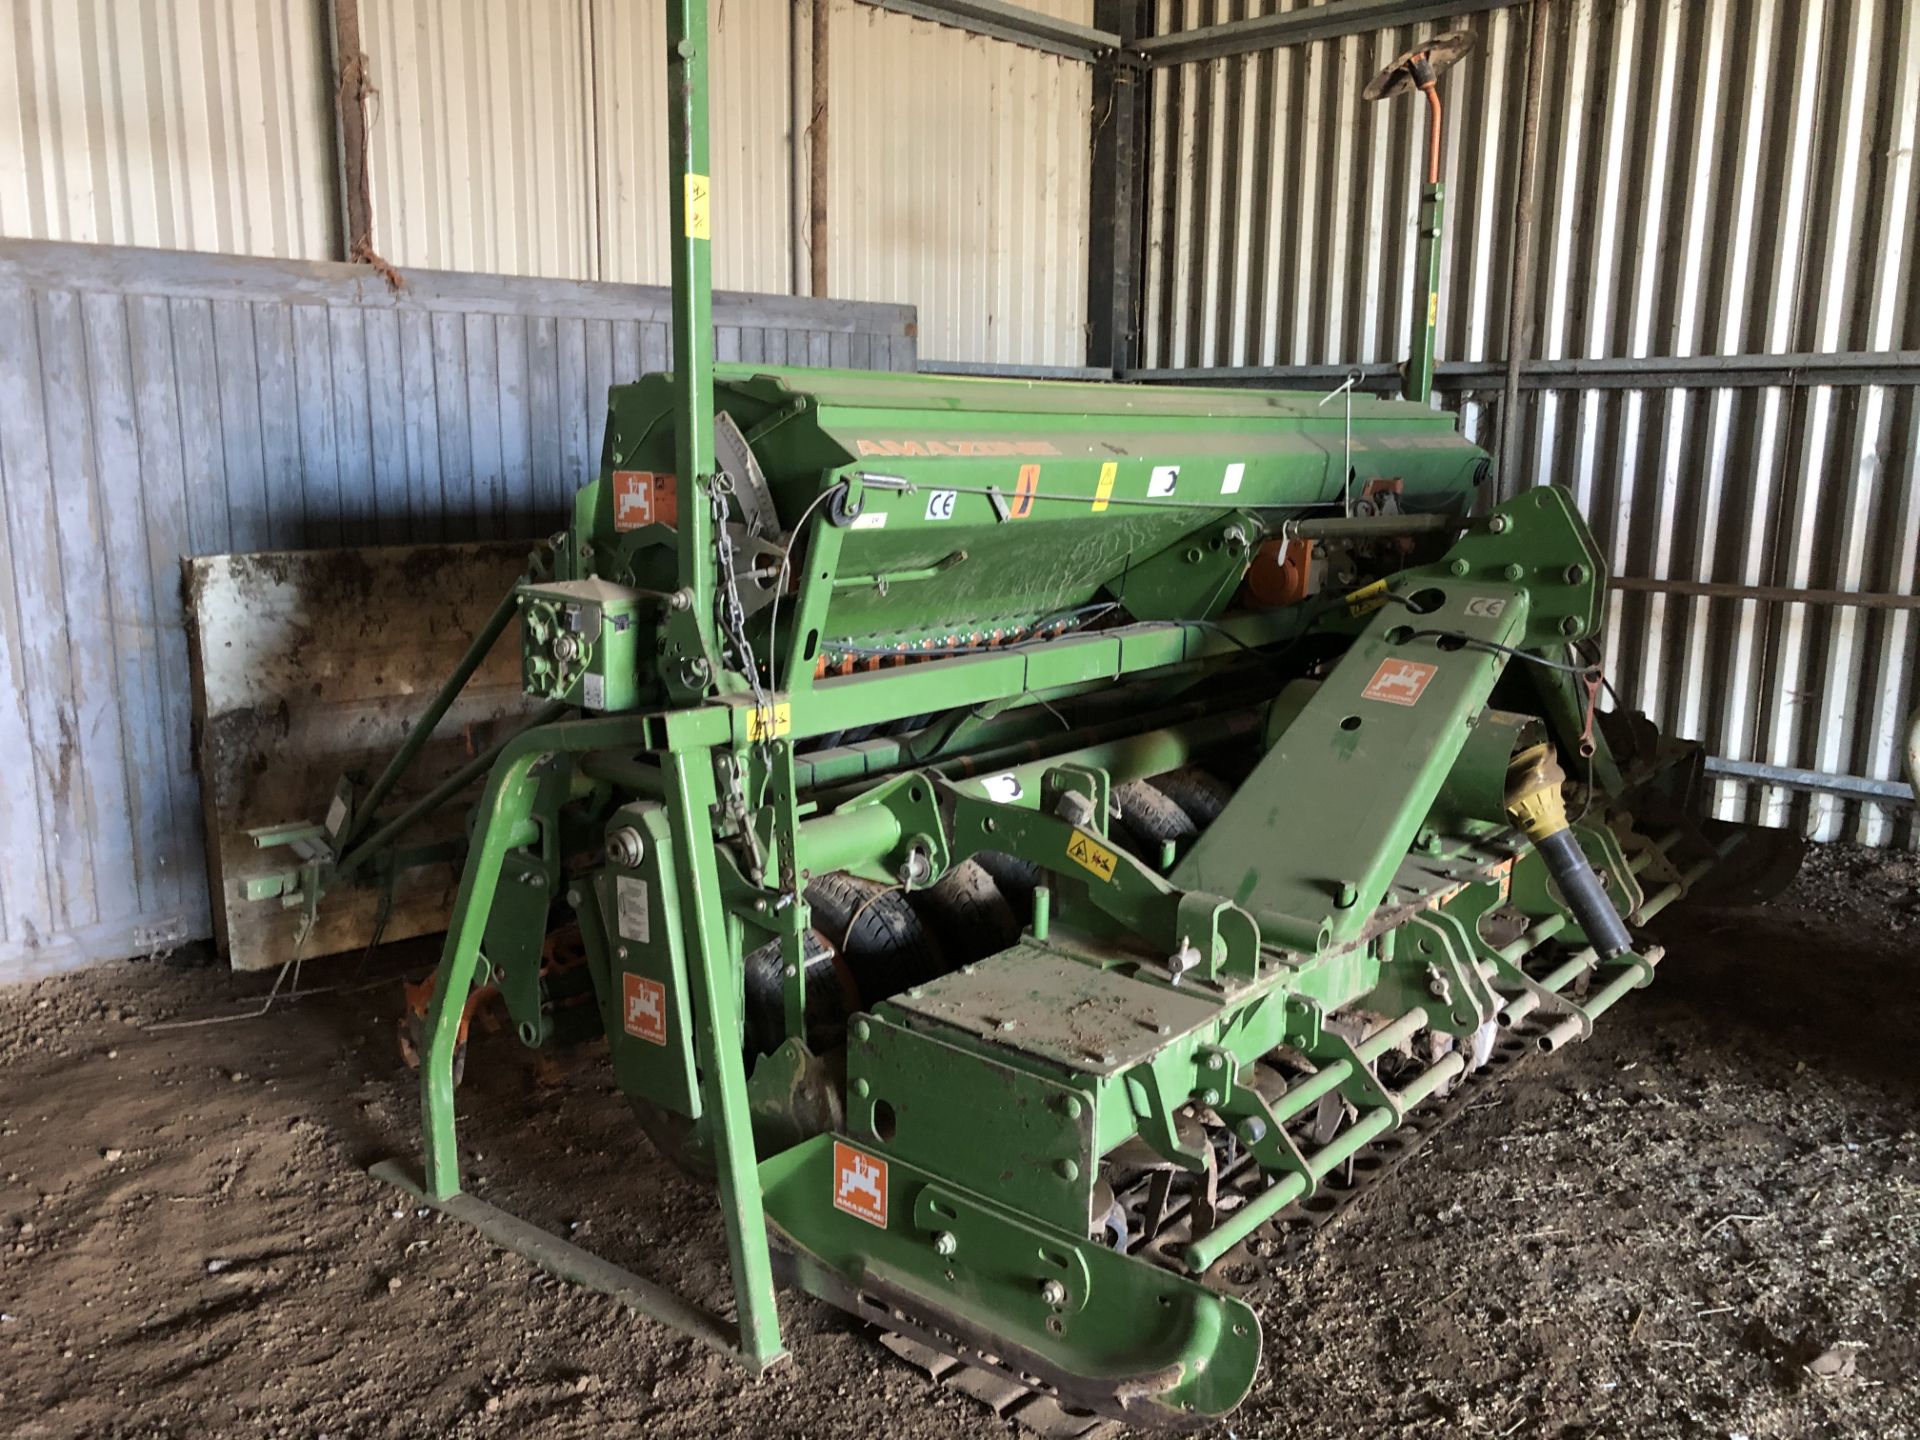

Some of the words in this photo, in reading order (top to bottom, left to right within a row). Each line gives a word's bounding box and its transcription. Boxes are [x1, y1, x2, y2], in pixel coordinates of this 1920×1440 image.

[929, 493, 954, 517] CE
[1469, 599, 1503, 616] CE
[836, 1196, 885, 1223] AMAZONE
